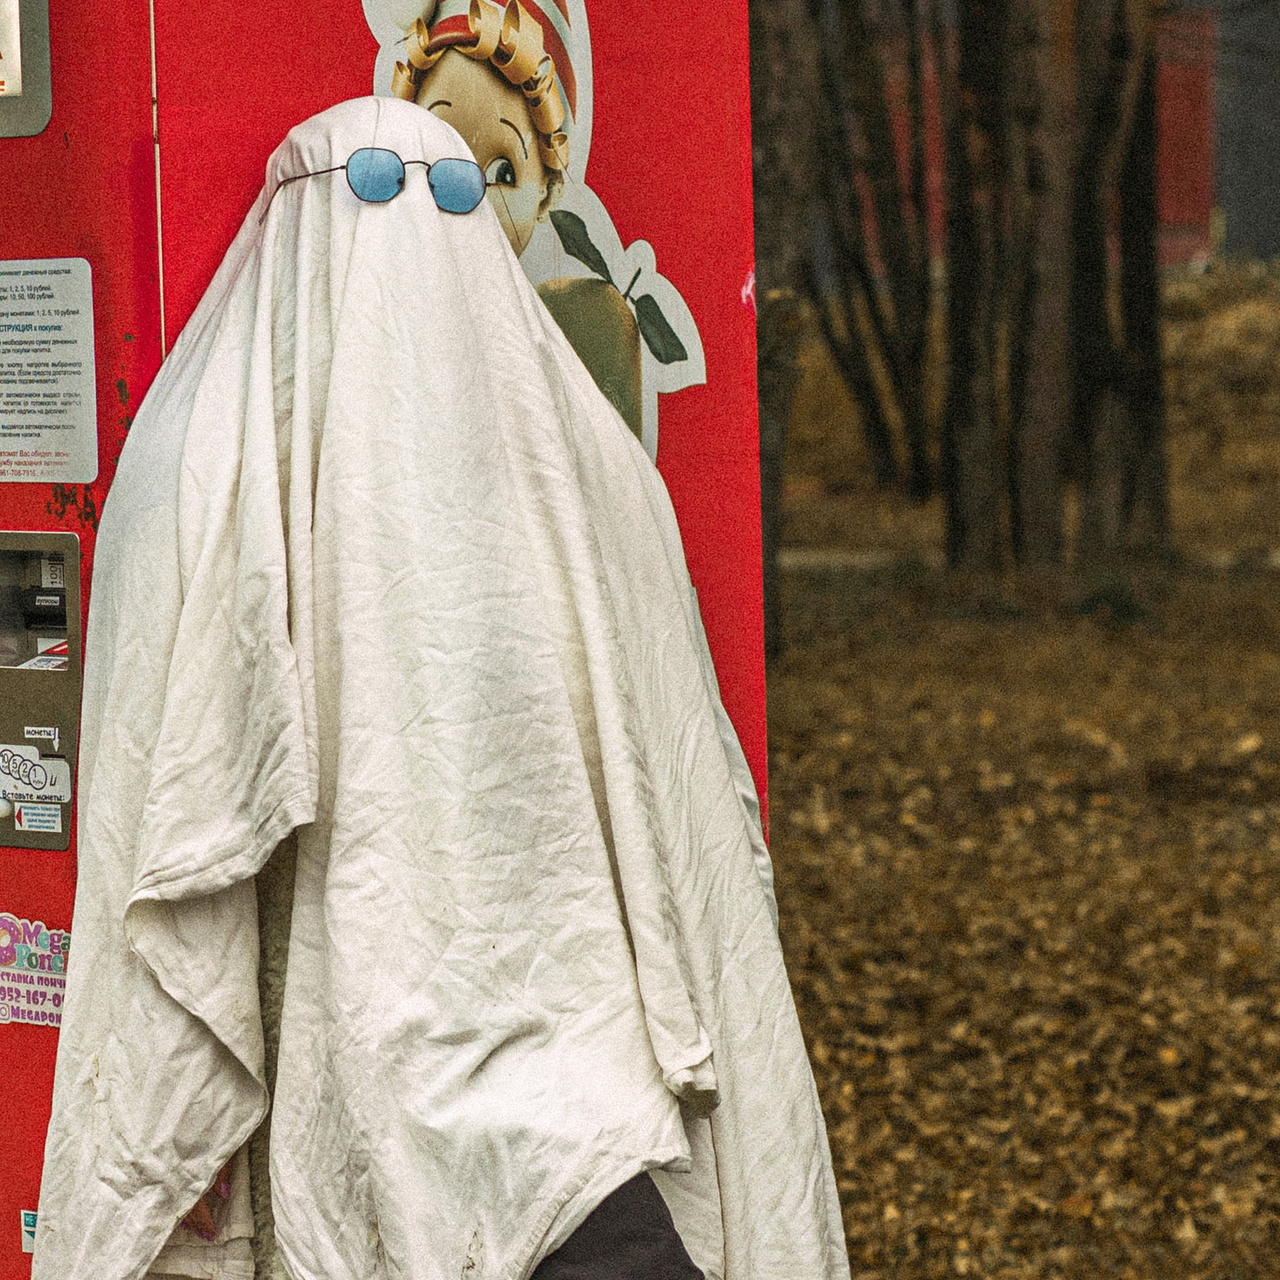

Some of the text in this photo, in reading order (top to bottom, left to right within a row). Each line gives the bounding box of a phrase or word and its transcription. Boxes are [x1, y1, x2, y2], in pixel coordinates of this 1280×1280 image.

[50, 565, 59, 586] 100
[1, 753, 9, 764] 10
[12, 759, 18, 769] 5
[22, 763, 28, 773] 2
[32, 768, 37, 778] 1
[2, 790, 34, 800] Вставьте
[21, 922, 71, 955] Mega
